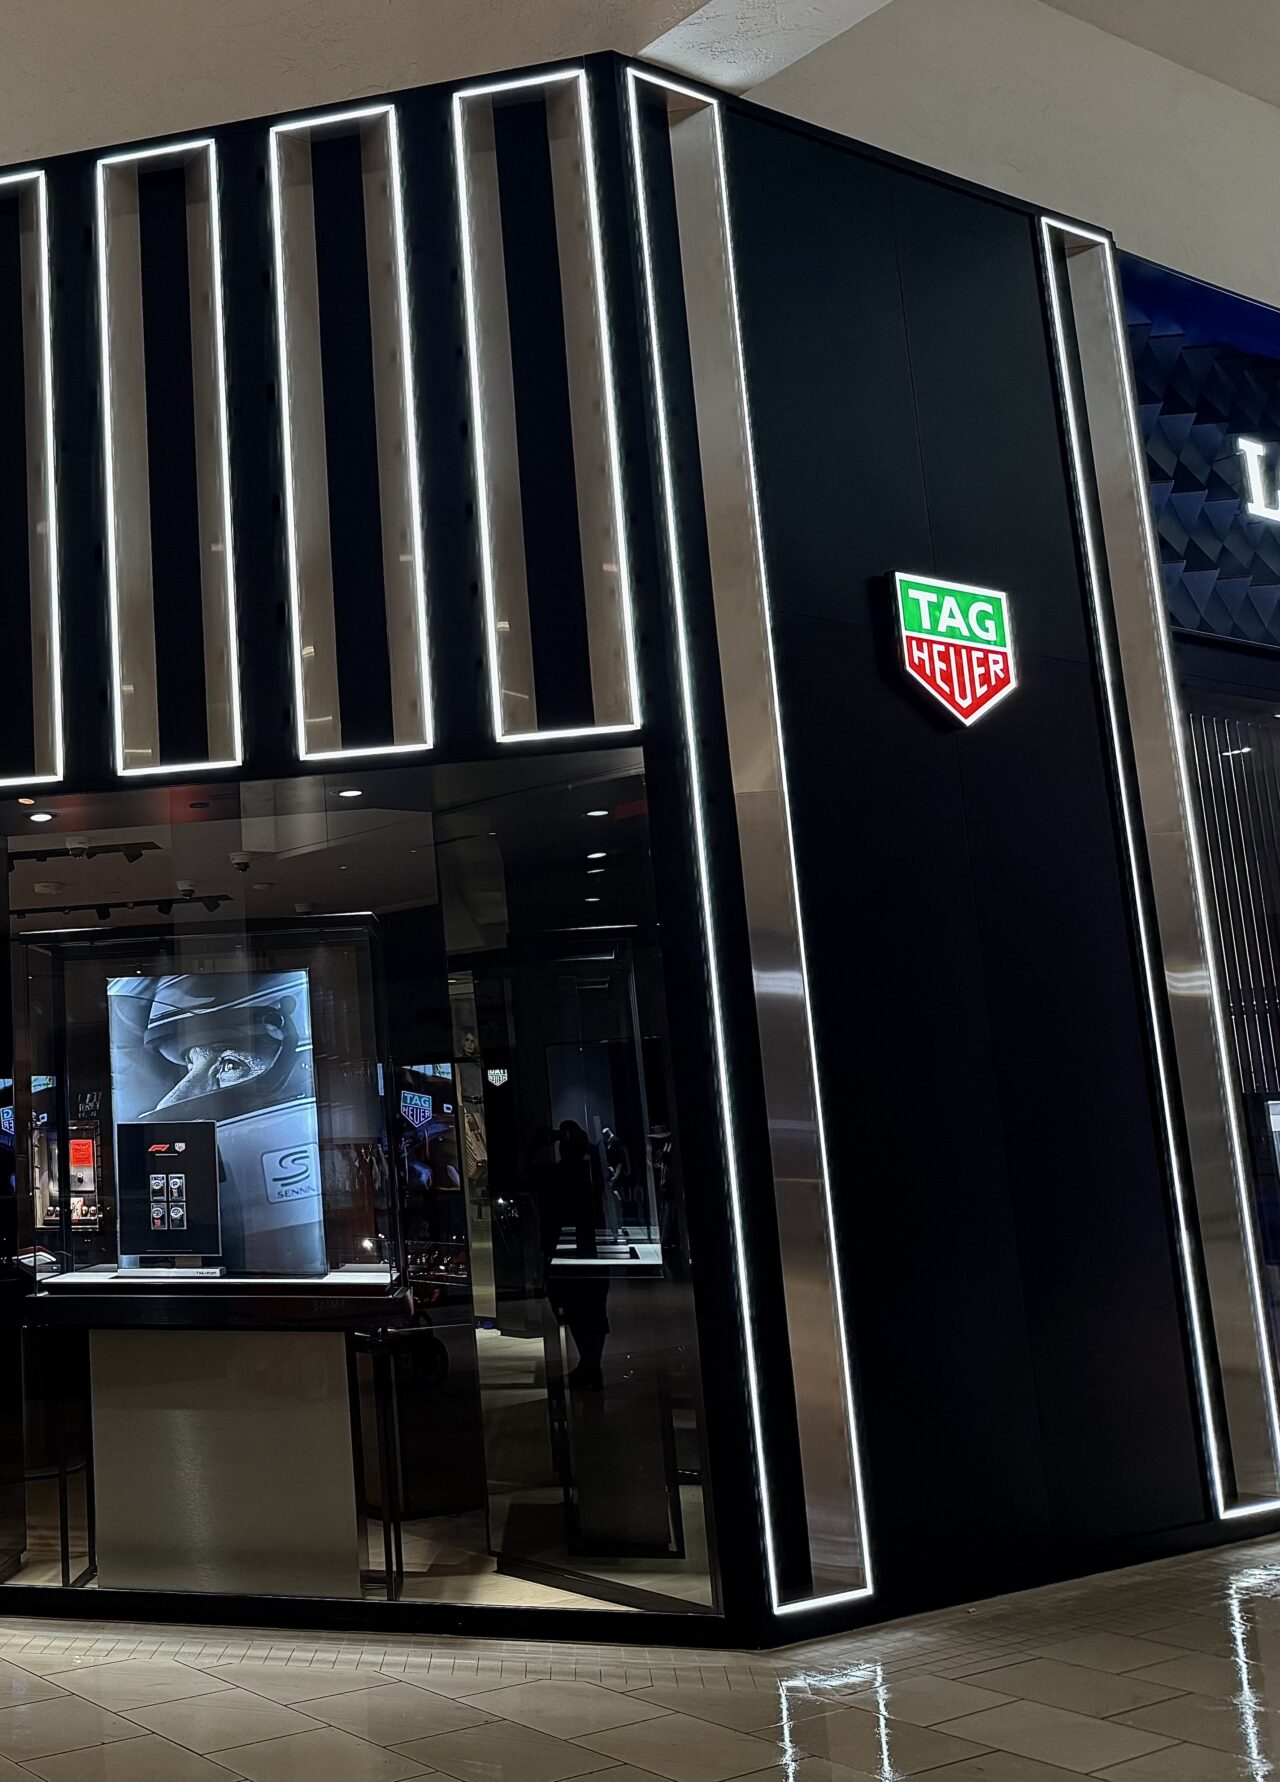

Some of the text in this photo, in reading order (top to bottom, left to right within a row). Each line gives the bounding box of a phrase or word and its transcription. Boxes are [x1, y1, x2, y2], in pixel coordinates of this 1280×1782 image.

[908, 588, 997, 642] TAG
[912, 639, 1005, 709] HEUER
[404, 1093, 430, 1107] TAG
[402, 1106, 431, 1124] HEUER
[277, 1185, 316, 1199] SENNA
